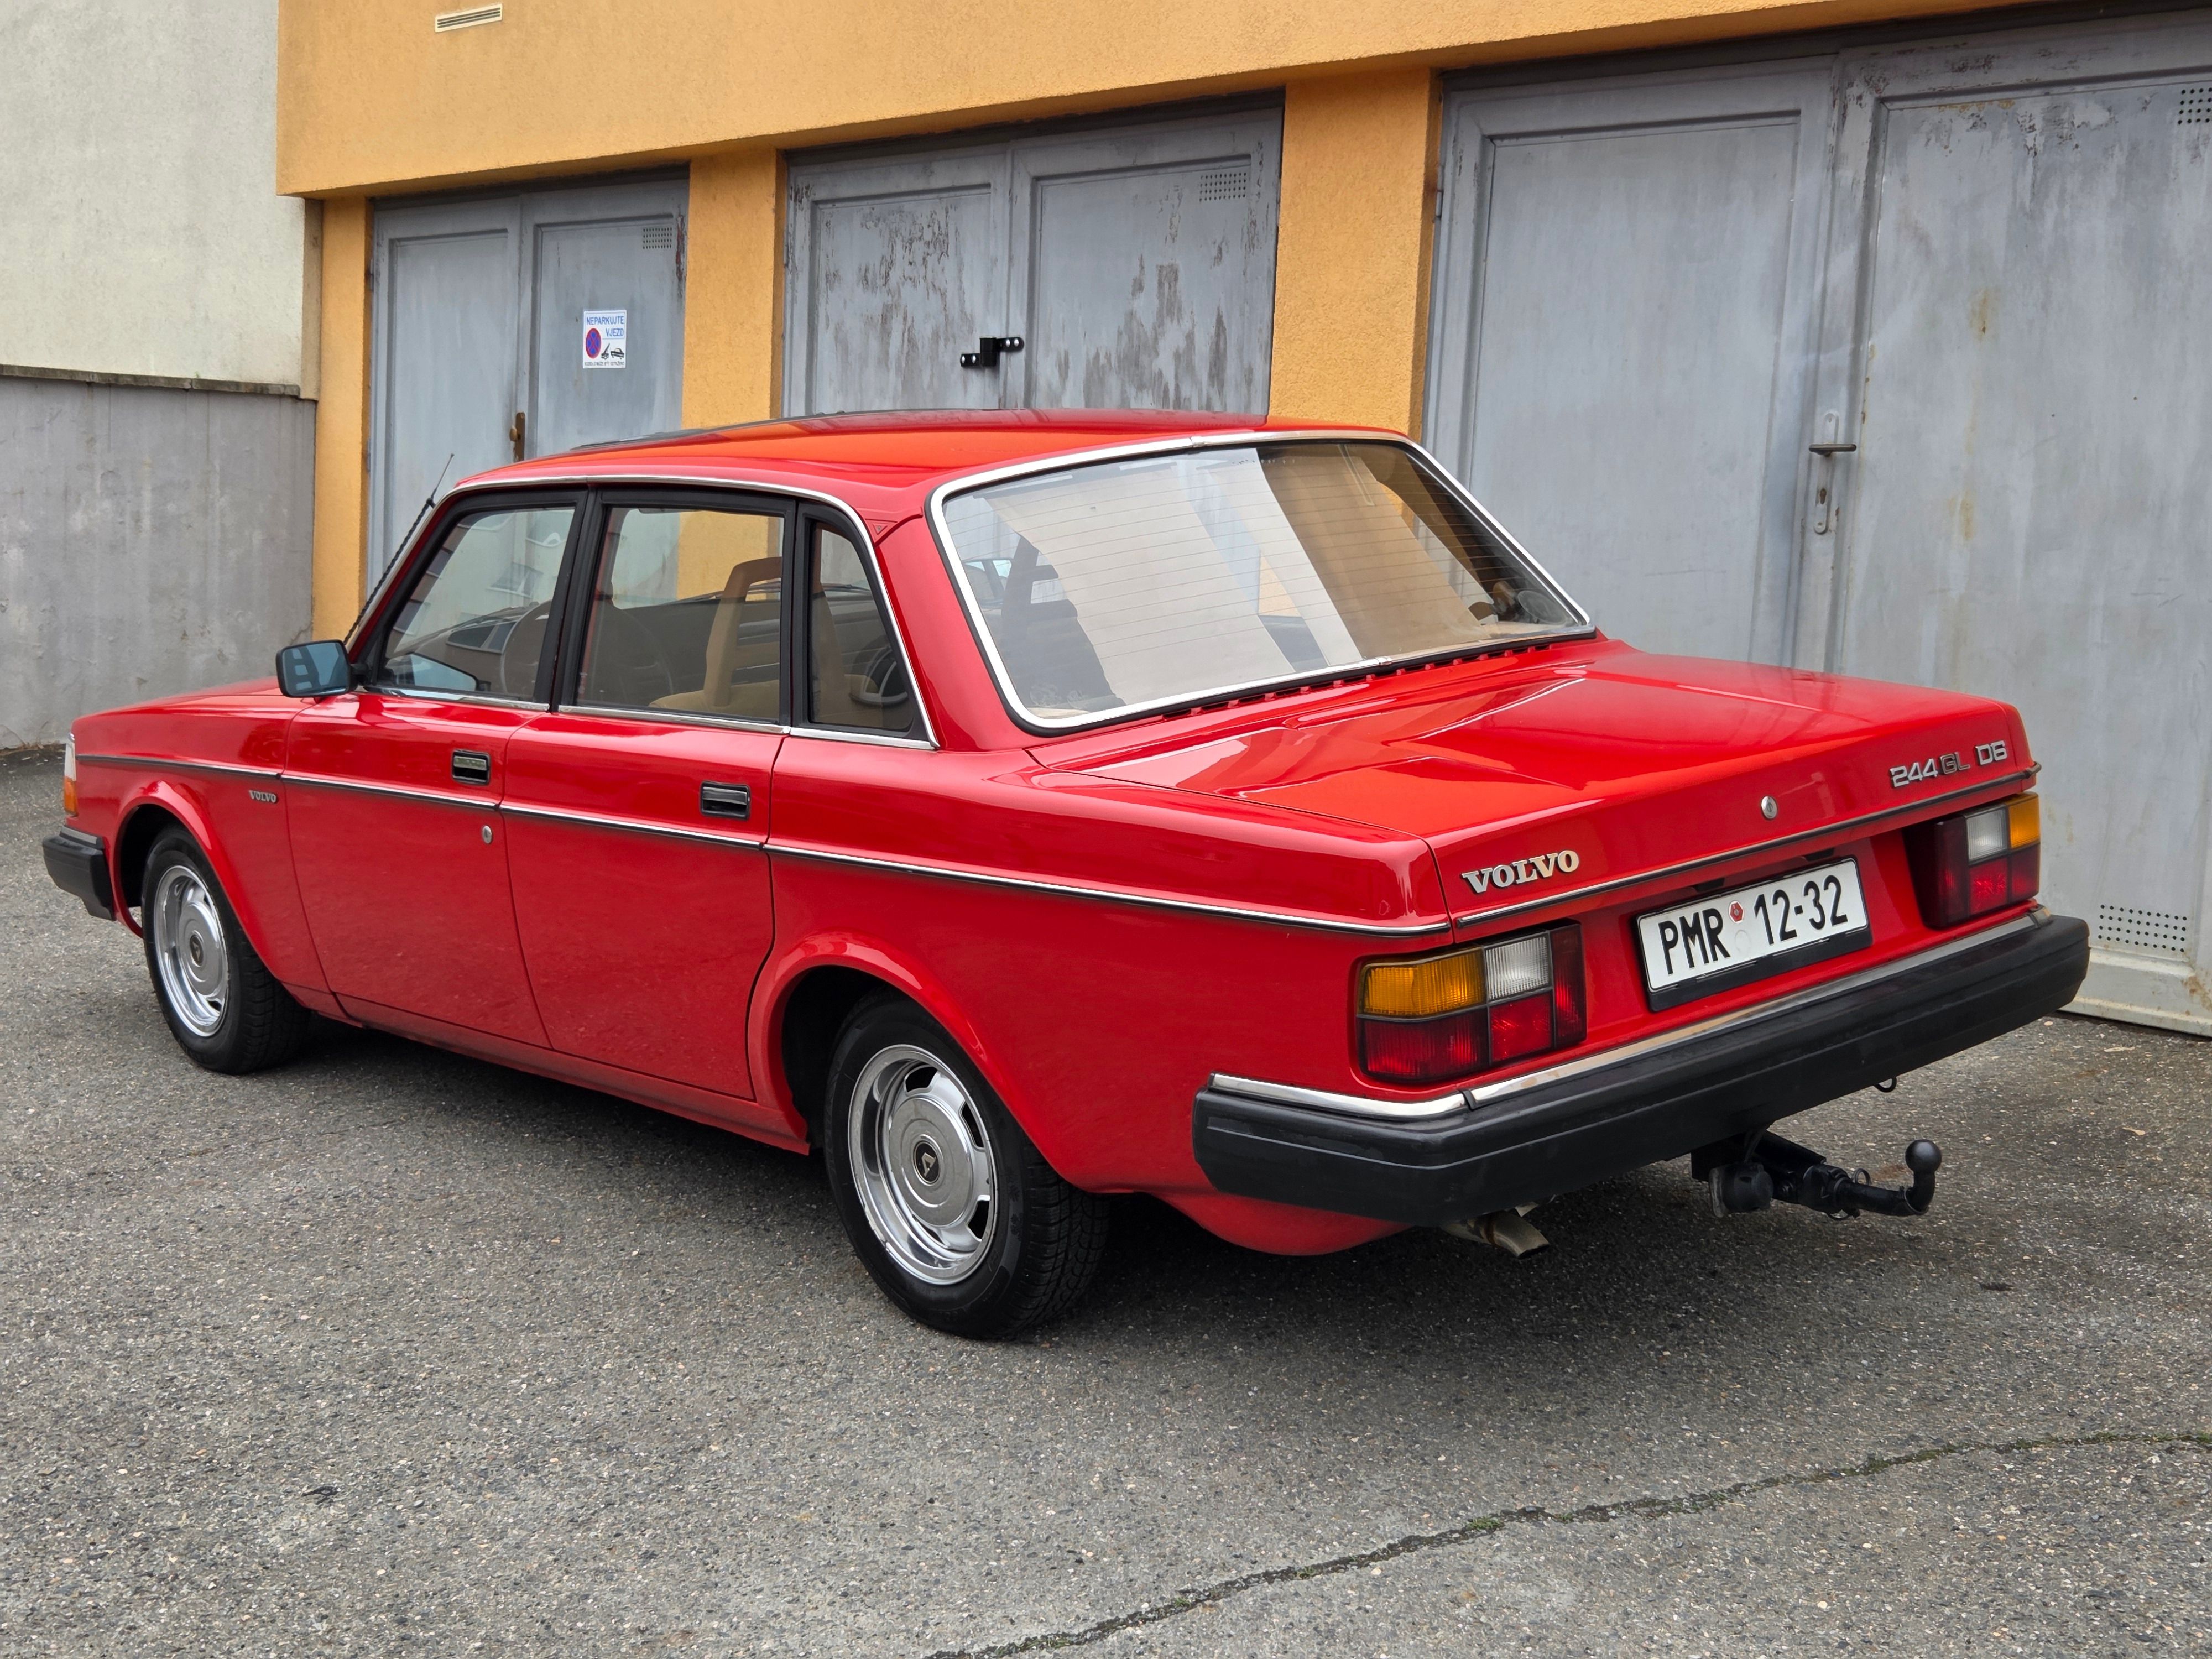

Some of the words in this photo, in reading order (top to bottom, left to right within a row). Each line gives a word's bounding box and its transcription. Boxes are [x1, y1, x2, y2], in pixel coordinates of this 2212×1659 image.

[586, 316, 624, 325] NEPARKUJTE
[606, 328, 624, 337] VJEZD
[1890, 758, 1938, 788] 244
[1939, 752, 1971, 775] GL
[1974, 740, 2007, 766] D6
[248, 790, 277, 804] VOLVO
[1461, 849, 1580, 894] VOLVO
[1658, 907, 1731, 975] PMR
[1753, 874, 1849, 946] 12-32
